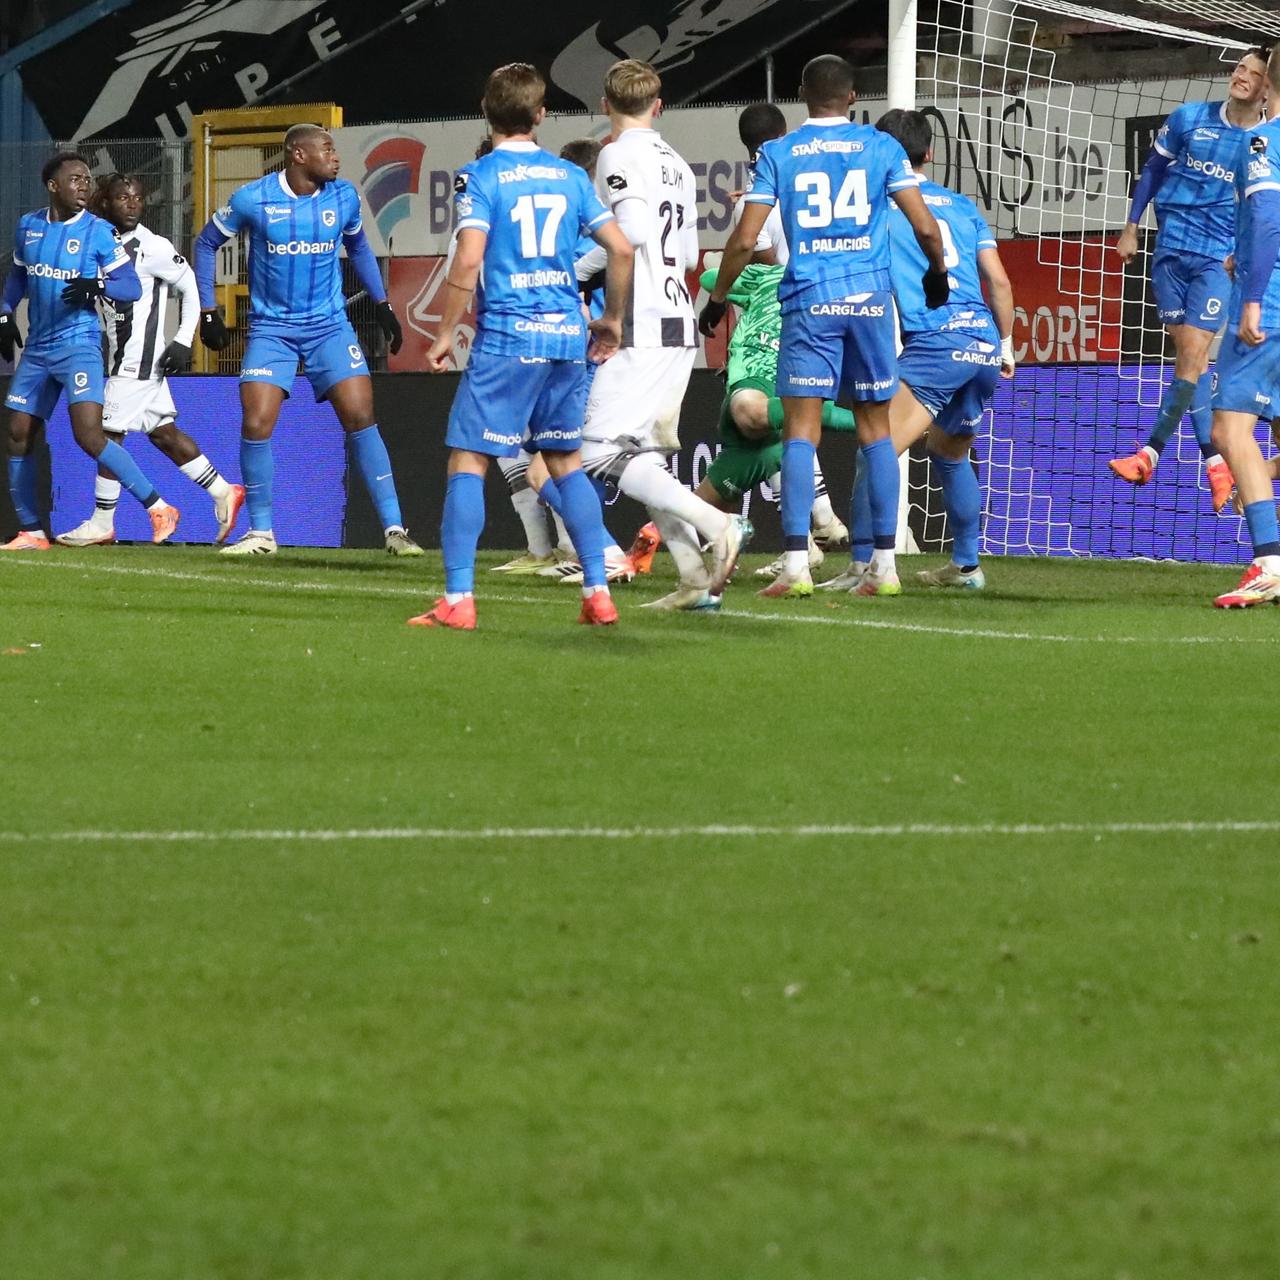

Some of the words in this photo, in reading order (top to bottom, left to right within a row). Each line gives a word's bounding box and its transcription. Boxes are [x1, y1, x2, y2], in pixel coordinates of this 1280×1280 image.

[794, 169, 872, 229] 34
[510, 194, 567, 259] 17
[798, 241, 810, 255] A.
[812, 235, 871, 253] PALACIOS
[221, 246, 233, 276] 11
[810, 304, 885, 317] CARGLASS
[514, 321, 581, 335] CARGLASS
[1011, 305, 1099, 363] CORE
